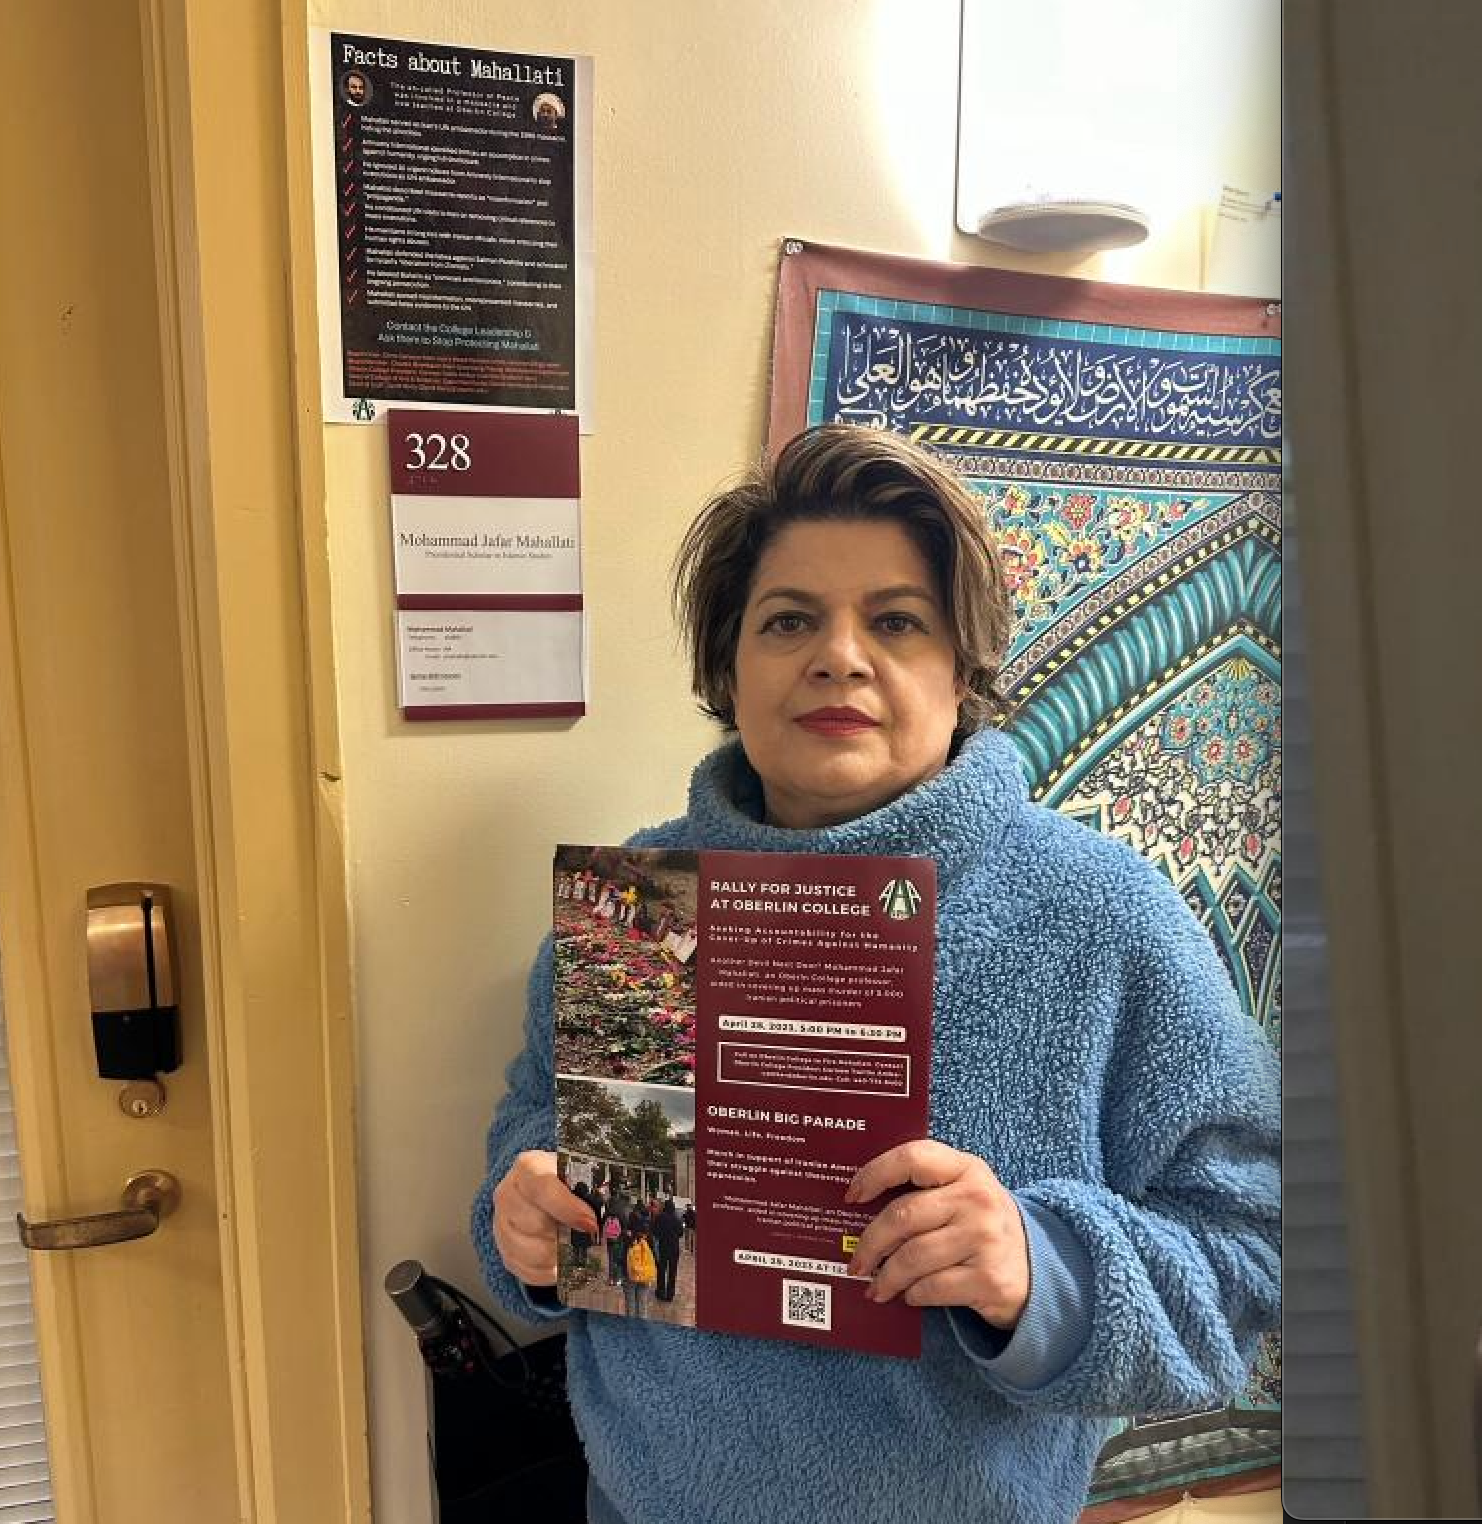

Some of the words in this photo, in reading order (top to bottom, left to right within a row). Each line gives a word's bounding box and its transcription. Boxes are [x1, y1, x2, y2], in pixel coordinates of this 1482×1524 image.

[342, 43, 399, 69] Facts
[408, 52, 462, 76] about
[470, 59, 565, 87] Mahallati
[386, 320, 422, 331] Contact
[440, 323, 474, 336] College
[432, 336, 453, 348] Stop
[404, 432, 472, 471] 328
[400, 533, 478, 547] Mohammad
[481, 533, 513, 547] Jafar
[516, 535, 575, 549] Mahallati
[711, 881, 757, 893] RALLY
[760, 883, 791, 895] FOR
[794, 883, 857, 897] JUSTICE
[710, 898, 730, 909] AT
[732, 899, 798, 913] OBERLIN
[802, 902, 871, 917] COLLEGE
[709, 925, 752, 935] Seeking
[755, 926, 836, 939] Accountability
[840, 931, 857, 939] for
[860, 931, 879, 939] the
[761, 937, 772, 945] of
[776, 937, 813, 946] Crimes
[817, 939, 860, 950] Against
[864, 942, 918, 953] Humanity
[811, 973, 845, 985] College
[722, 1019, 748, 1029] April
[826, 1026, 842, 1035] PM
[886, 1029, 902, 1038] PM
[707, 1105, 770, 1122] OBERLIN
[774, 1111, 800, 1125] BIG
[803, 1114, 867, 1131] PARADE
[738, 1253, 767, 1264] APRIL
